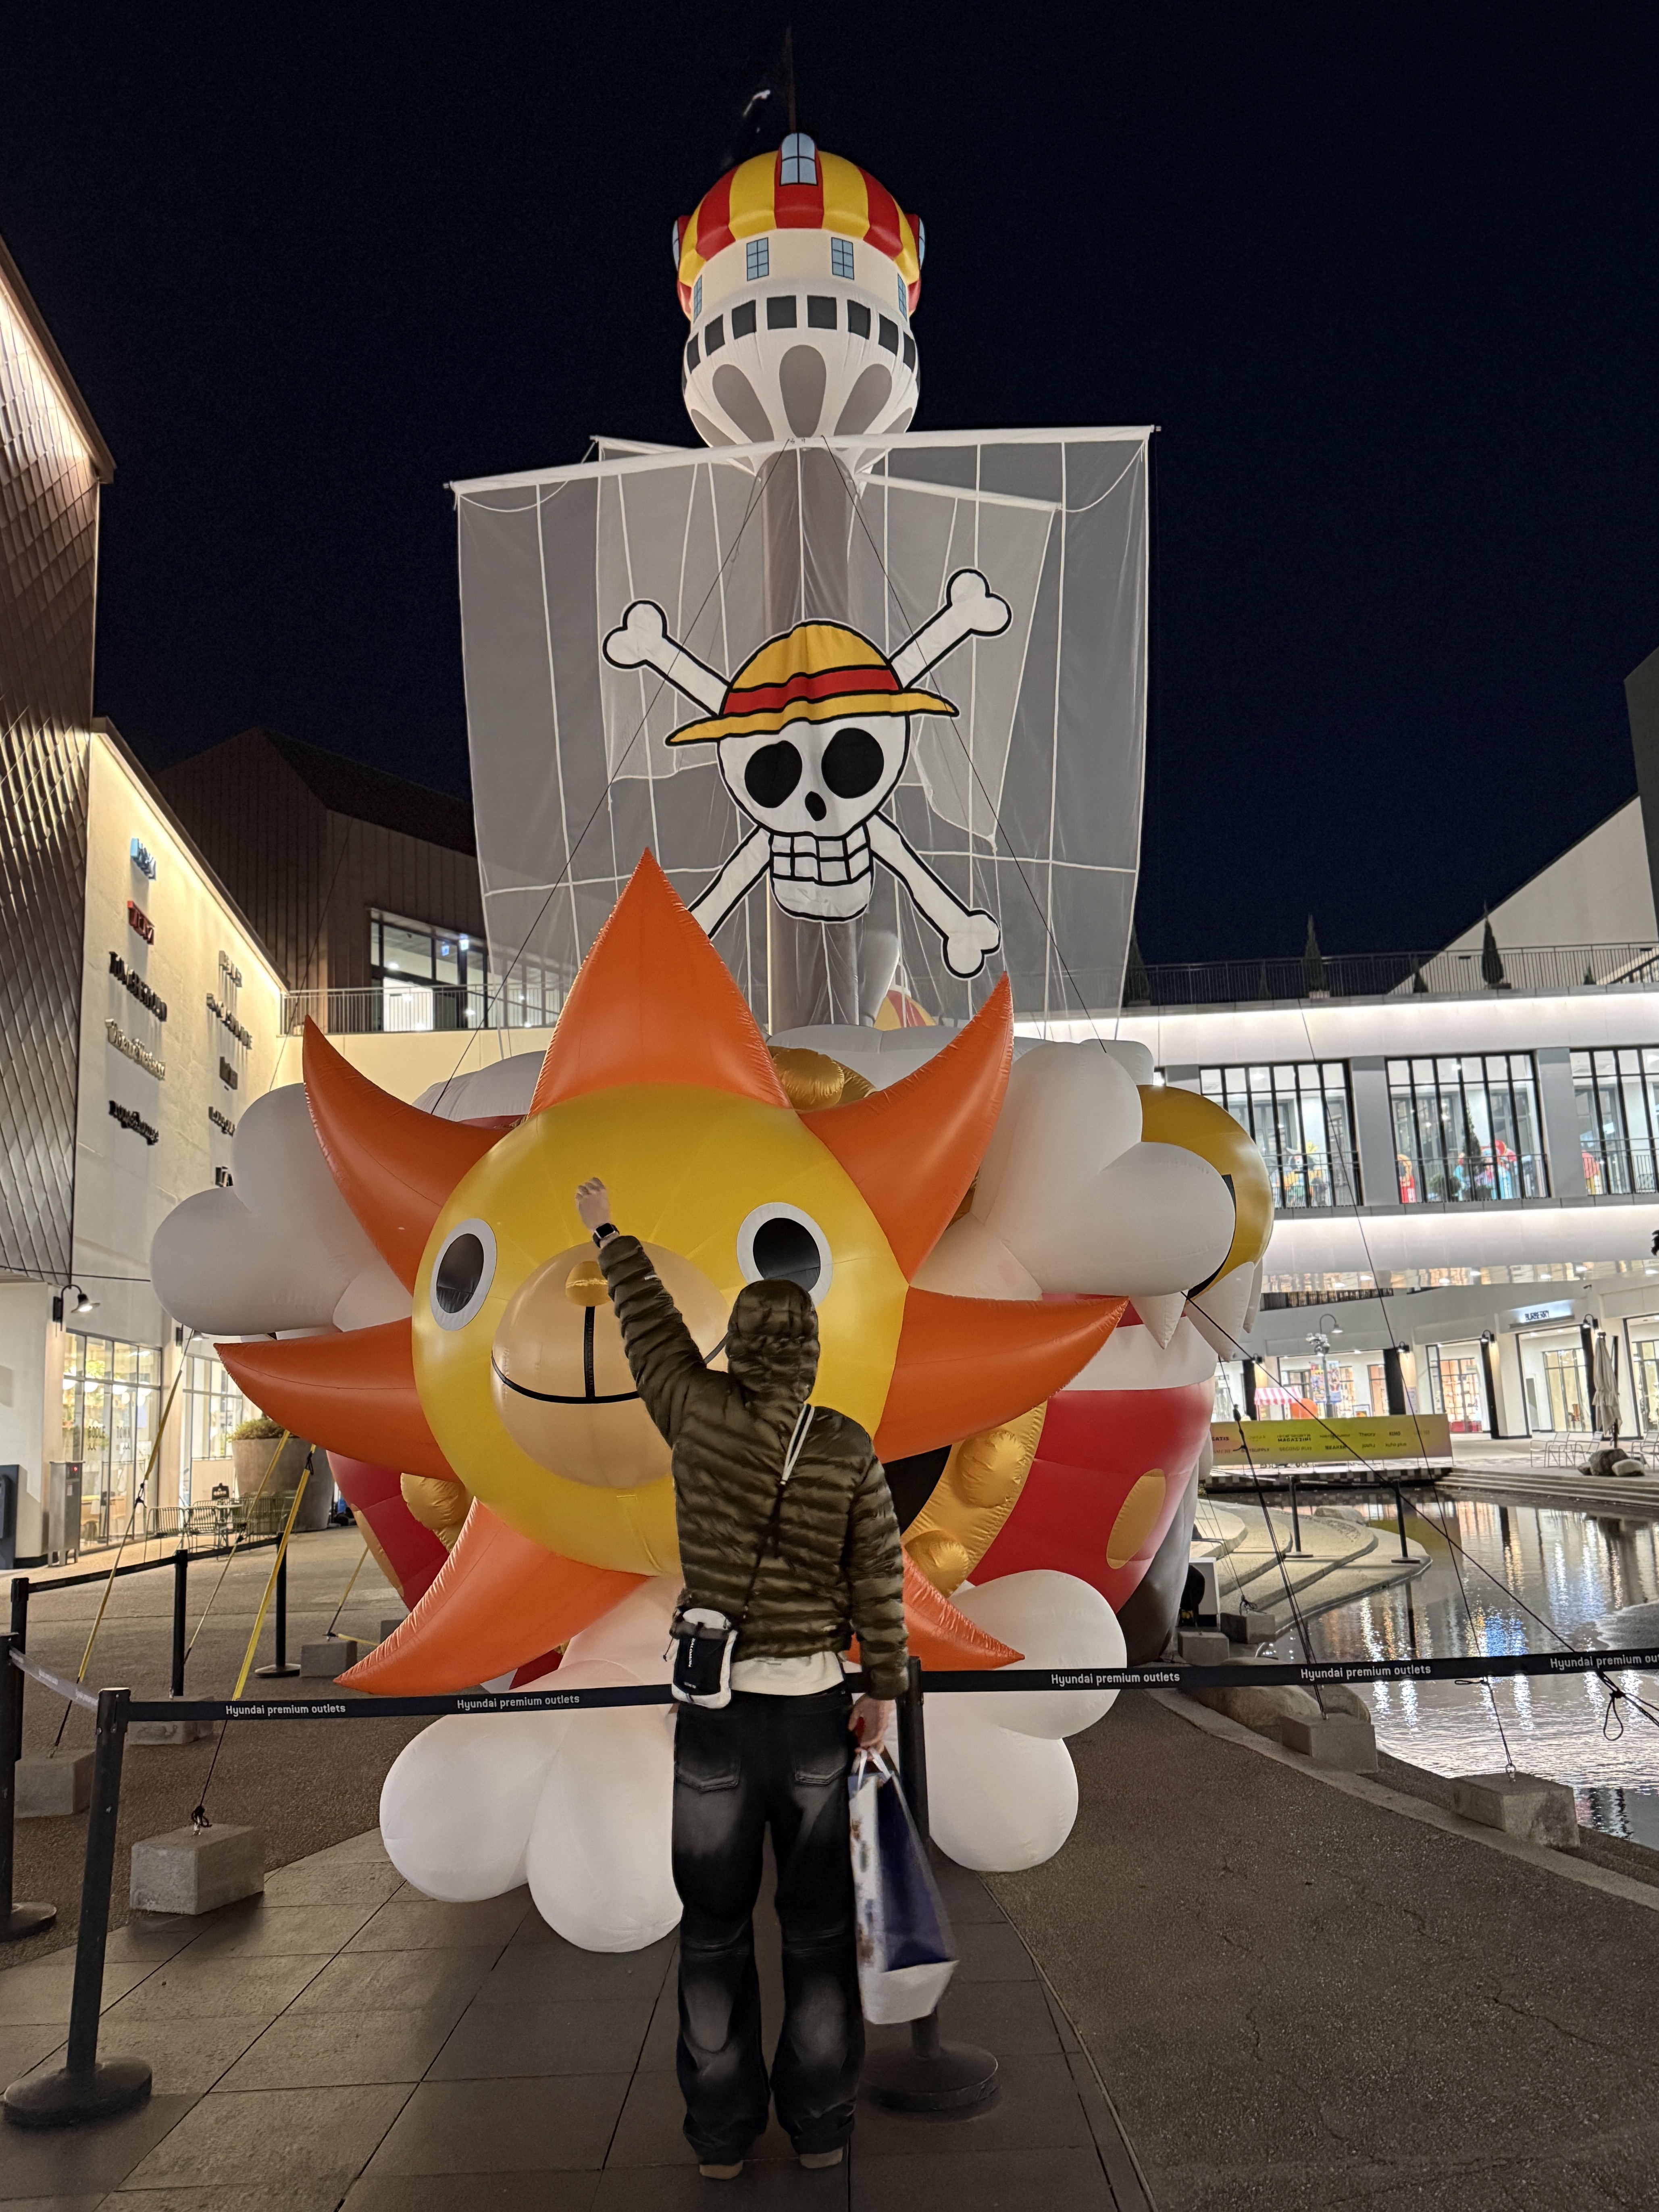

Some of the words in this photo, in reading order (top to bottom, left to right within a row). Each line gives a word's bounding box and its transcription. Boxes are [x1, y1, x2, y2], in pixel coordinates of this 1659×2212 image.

[1550, 1656, 1593, 1670] Hyundai
[1596, 1654, 1642, 1668] premium
[1051, 1673, 1093, 1687] Hyundai
[1096, 1673, 1141, 1686] premium
[1143, 1672, 1180, 1683] outlets
[1301, 1667, 1343, 1681] Hyundai
[1346, 1666, 1391, 1680] premium
[1394, 1664, 1431, 1675] outlets
[225, 1705, 265, 1717] Hyundai
[267, 1704, 309, 1716] premium
[311, 1704, 346, 1713] outlets
[457, 1698, 497, 1711] Hyundai
[500, 1696, 542, 1709] premium
[544, 1695, 580, 1705] outlets
